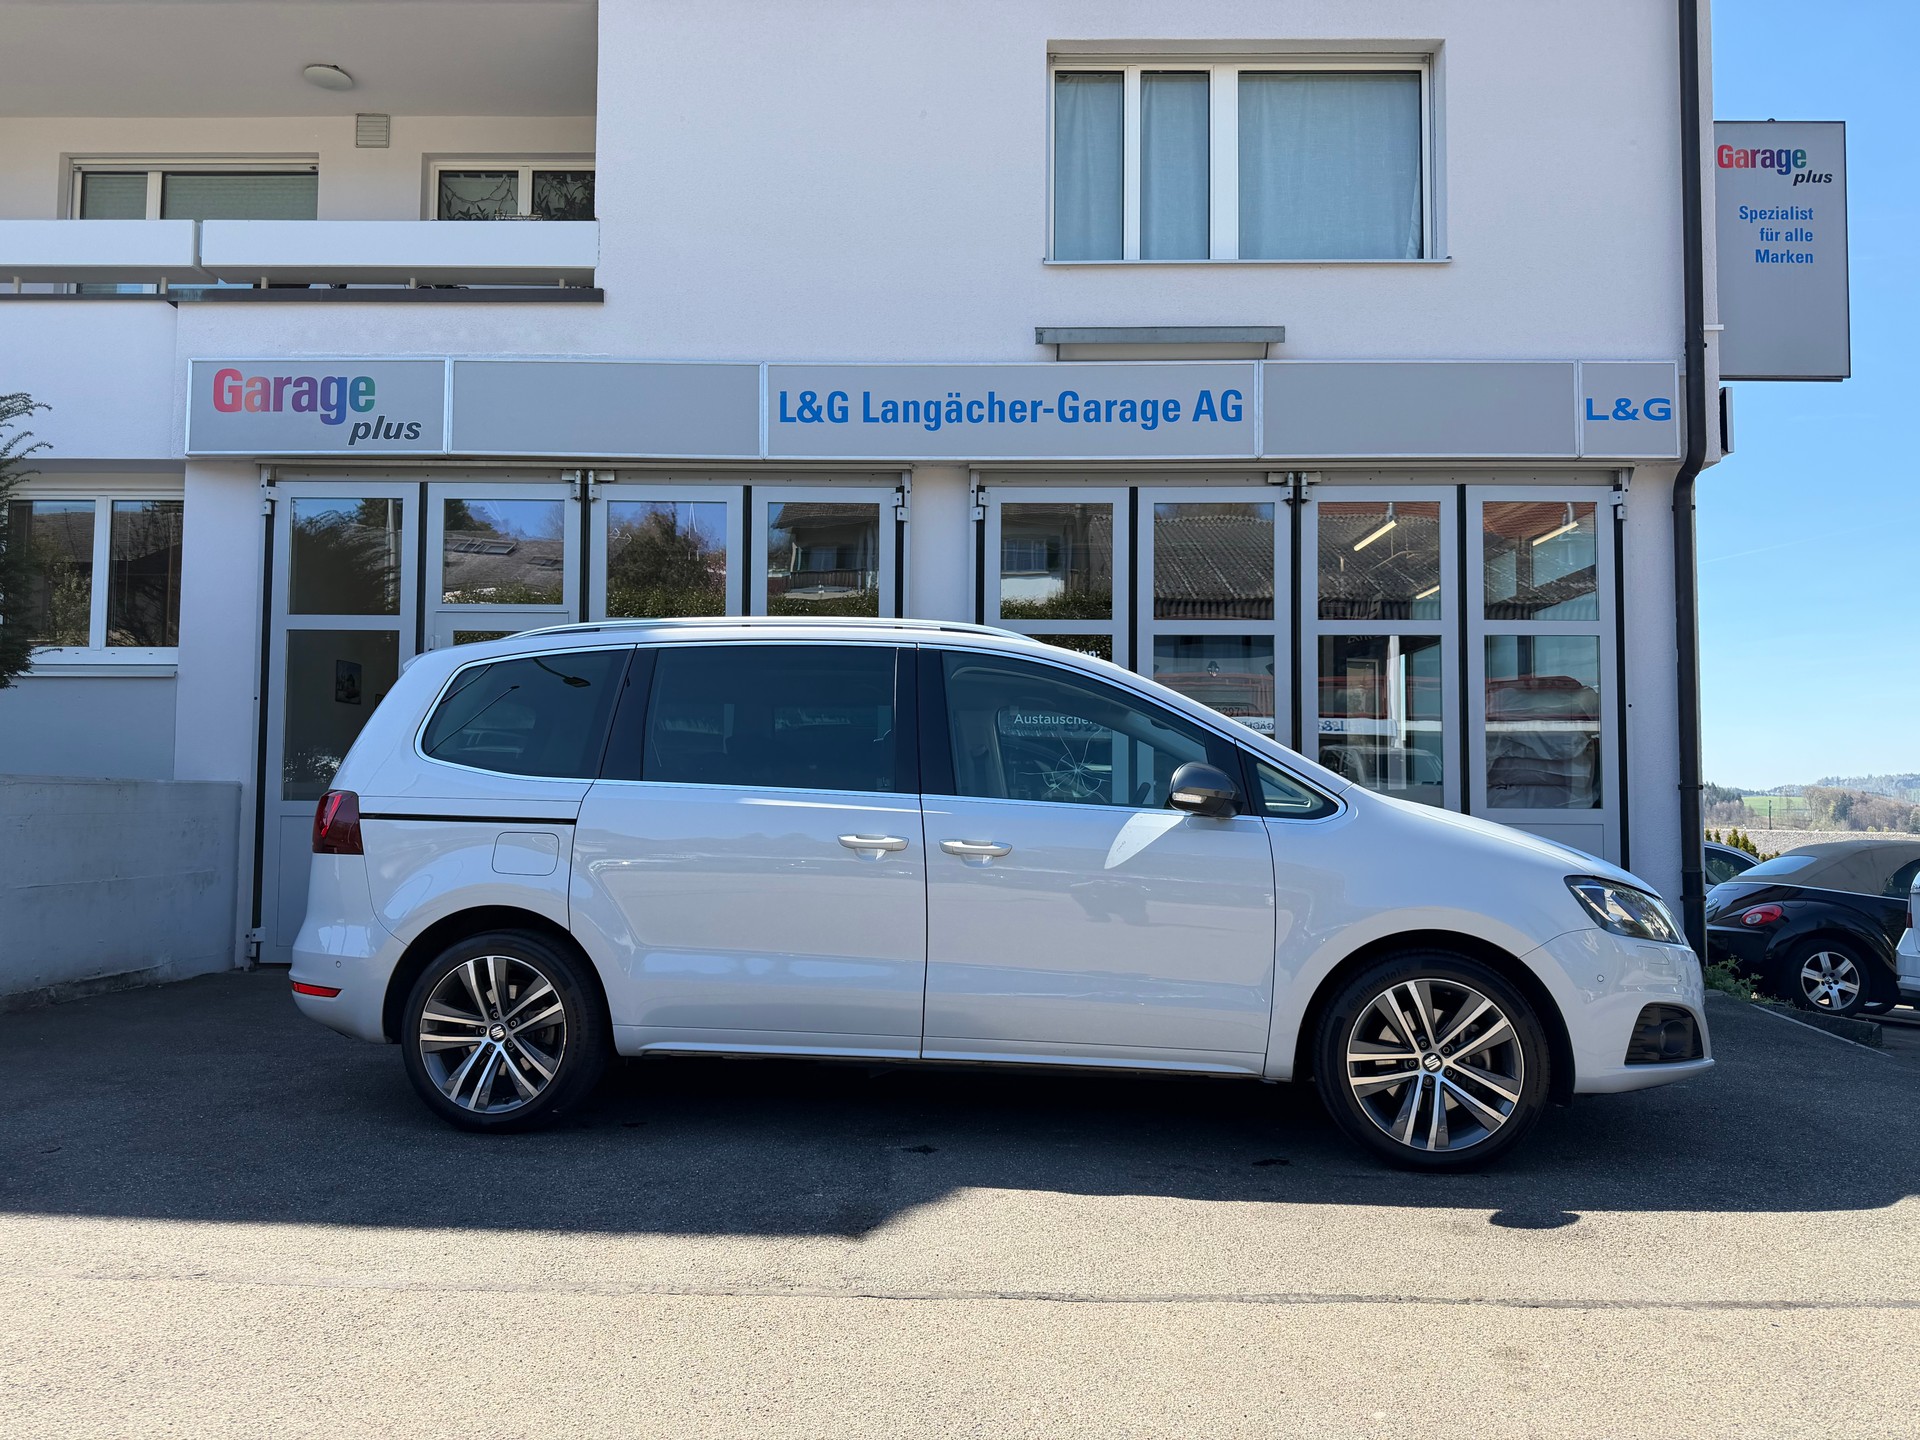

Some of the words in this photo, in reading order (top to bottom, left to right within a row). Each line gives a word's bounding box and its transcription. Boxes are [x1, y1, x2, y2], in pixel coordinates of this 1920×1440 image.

[1717, 144, 1807, 176] Garage
[1792, 169, 1833, 187] plus
[1738, 205, 1814, 223] Spezialist
[1759, 227, 1781, 242] für
[1784, 227, 1814, 242] alle
[1755, 249, 1814, 264] Marken
[213, 368, 376, 426] Garage
[779, 390, 849, 424] L&G
[862, 391, 1181, 431] Langächer-Garage
[1192, 389, 1243, 423] AG
[1586, 398, 1671, 421] L&G
[347, 415, 422, 446] plus
[1014, 713, 1093, 724] Austausche
